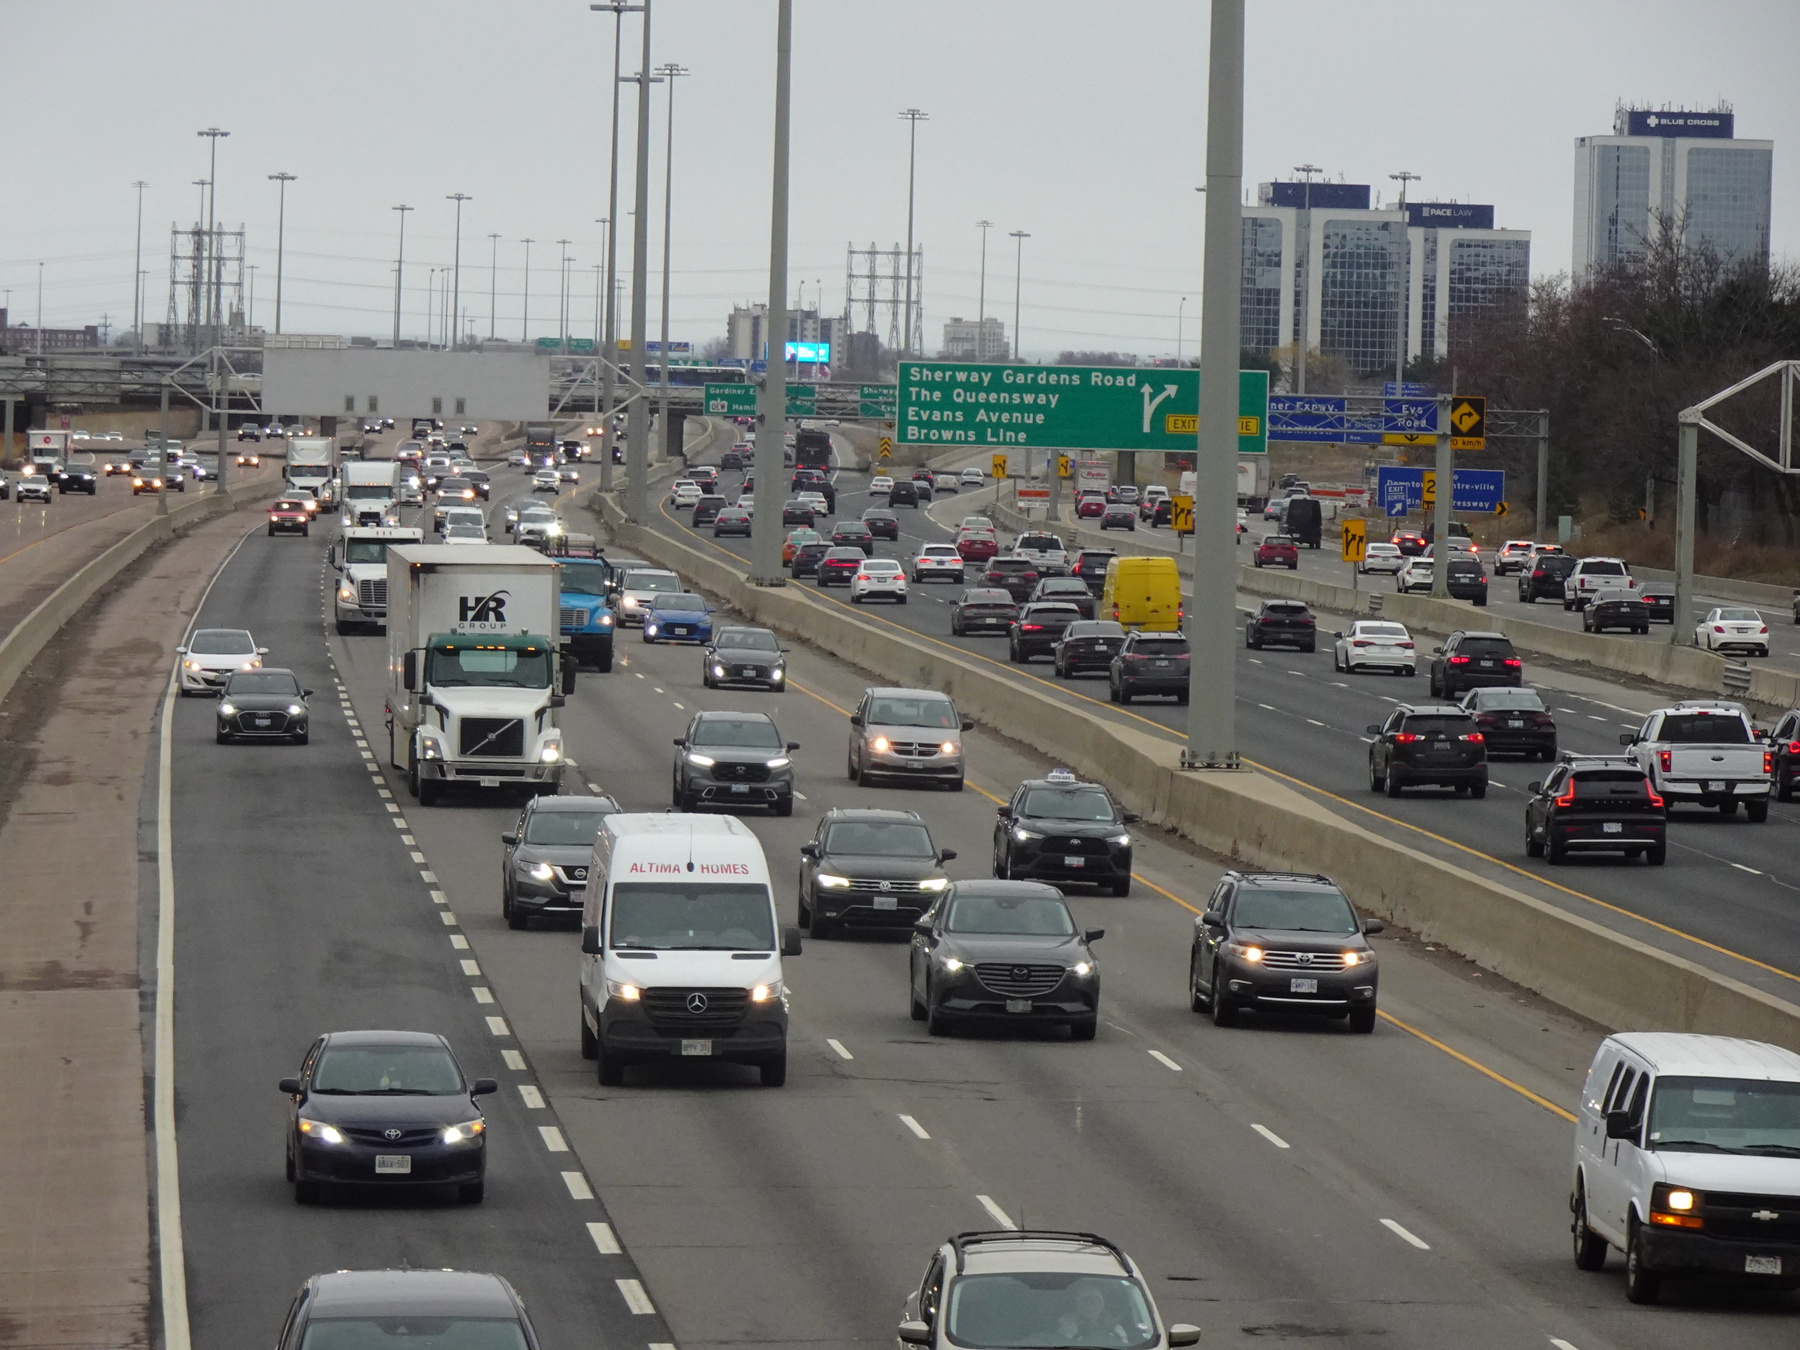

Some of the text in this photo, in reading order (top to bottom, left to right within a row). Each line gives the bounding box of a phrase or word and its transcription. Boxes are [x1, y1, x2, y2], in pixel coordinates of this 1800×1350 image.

[1430, 208, 1472, 217] PACE LAW
[910, 367, 1136, 387] Sherway Gardens Road
[709, 386, 746, 395] Gardiner
[908, 387, 1060, 408] The Queensway
[907, 406, 1046, 424] Evans Avenue
[1173, 418, 1198, 430] EXIT
[1398, 417, 1427, 428] Road
[907, 425, 1027, 443] Browns Line
[1462, 439, 1482, 447] km/h
[459, 595, 508, 622] HR
[458, 622, 507, 630] GROUP
[629, 862, 750, 875] ALTIMA HOMES
